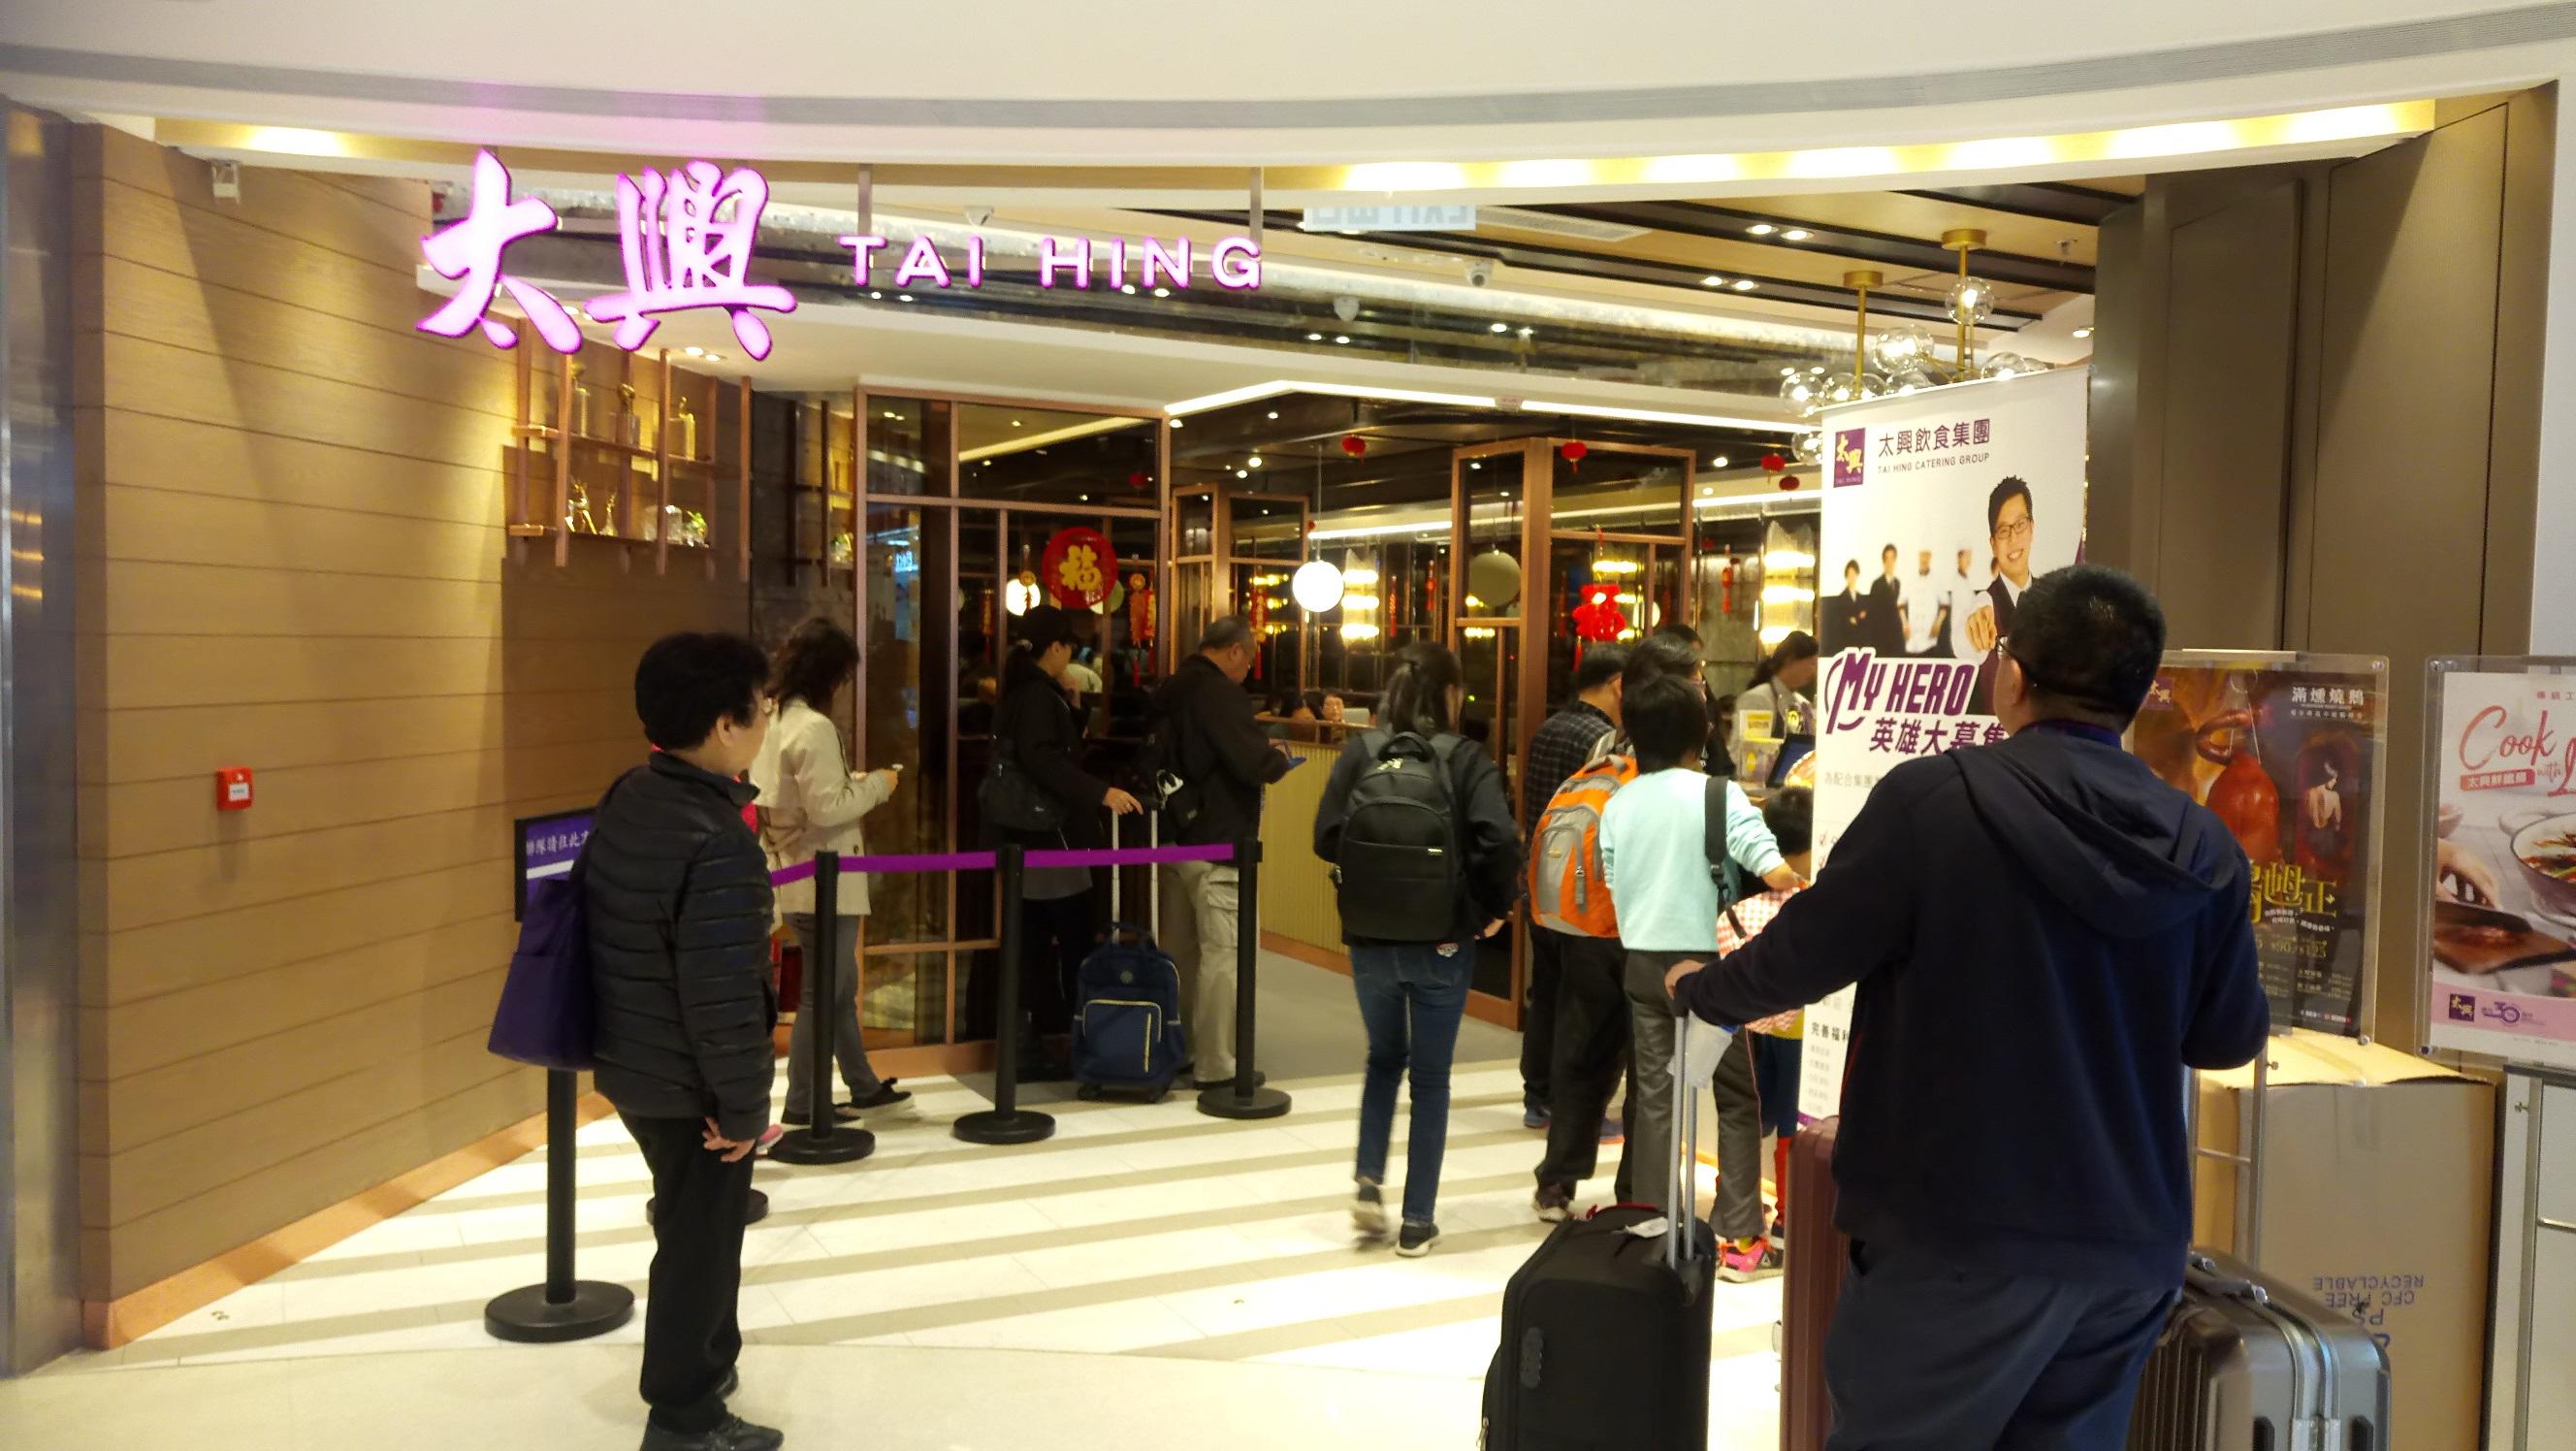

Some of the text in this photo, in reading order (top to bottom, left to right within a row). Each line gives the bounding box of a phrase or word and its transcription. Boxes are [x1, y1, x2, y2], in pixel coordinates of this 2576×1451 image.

[416, 147, 797, 360] 太興
[839, 234, 1262, 289] TAI HING
[1878, 418, 1990, 459] 太興飲食集團
[1878, 452, 1990, 473] TAI HING CATERING GROUP
[1886, 662, 1976, 717] HERO
[2459, 704, 2558, 771] Cook
[2312, 1274, 2425, 1291] RECYCLABLE
[2325, 1290, 2416, 1308] CFC FREE
